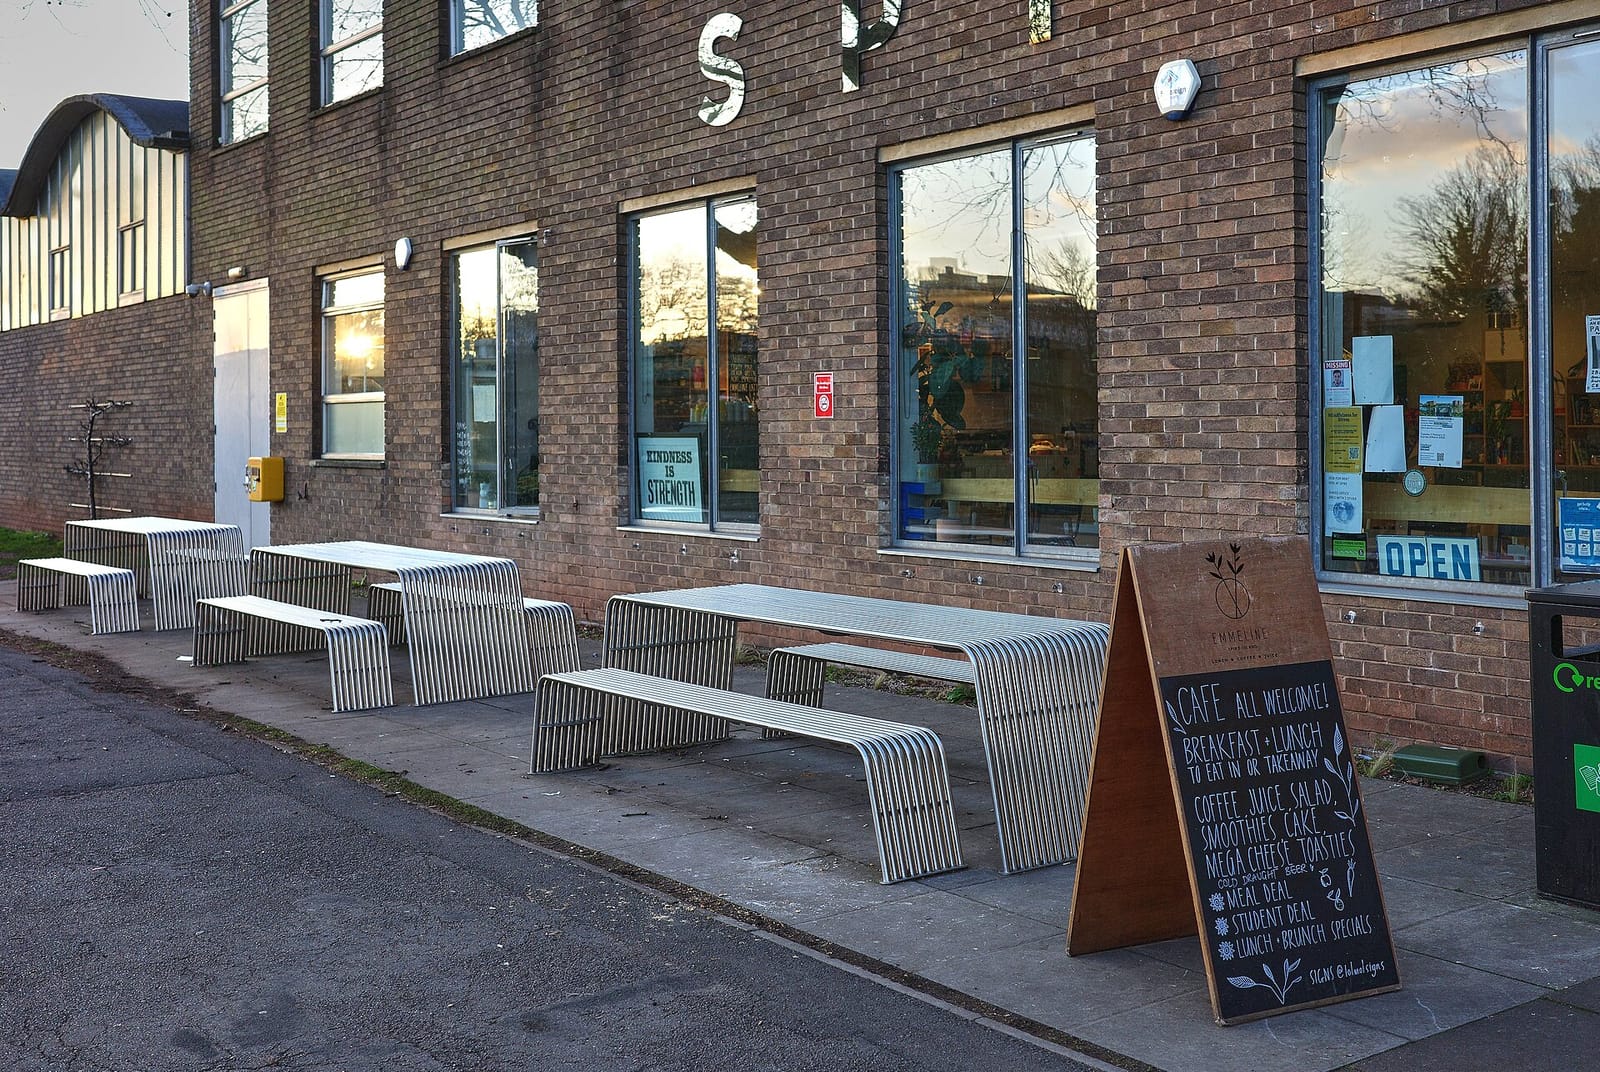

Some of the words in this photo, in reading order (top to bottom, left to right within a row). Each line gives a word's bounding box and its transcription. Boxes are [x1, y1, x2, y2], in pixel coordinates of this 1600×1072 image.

[1326, 361, 1348, 369] MISSING
[646, 450, 692, 463] KINDNESS
[665, 465, 675, 478] IS
[647, 479, 696, 507] STRENGTH
[1385, 541, 1472, 581] OPEN
[1211, 627, 1268, 645] EMMELINE
[1177, 683, 1226, 725] CAFE
[1236, 692, 1262, 719] ALL
[1263, 682, 1330, 716] WELCOME!
[1183, 729, 1260, 765] BREAKFAST
[1271, 721, 1323, 754] LUNCH
[1187, 765, 1201, 784] TO
[1206, 762, 1225, 781] EAT
[1230, 761, 1241, 778] IN
[1247, 758, 1261, 776] OR
[1264, 749, 1319, 774] TAKEAWAY
[1205, 847, 1247, 880] MEGA
[1247, 840, 1290, 875] CHEESE
[1297, 829, 1356, 865] TOASTIES
[1217, 876, 1238, 889] COLD
[1242, 867, 1279, 886] DRAUGHT
[1285, 864, 1308, 877] BEER
[1226, 886, 1258, 910] MEAL
[1263, 879, 1294, 905] DEAL
[1231, 905, 1284, 935] STUDENT
[1287, 900, 1316, 923] DEAL
[1235, 933, 1274, 959] LUNCH
[1281, 923, 1326, 950] BRUNCH
[1331, 915, 1372, 941] SPECIALS
[1309, 965, 1335, 985] SIGNS
